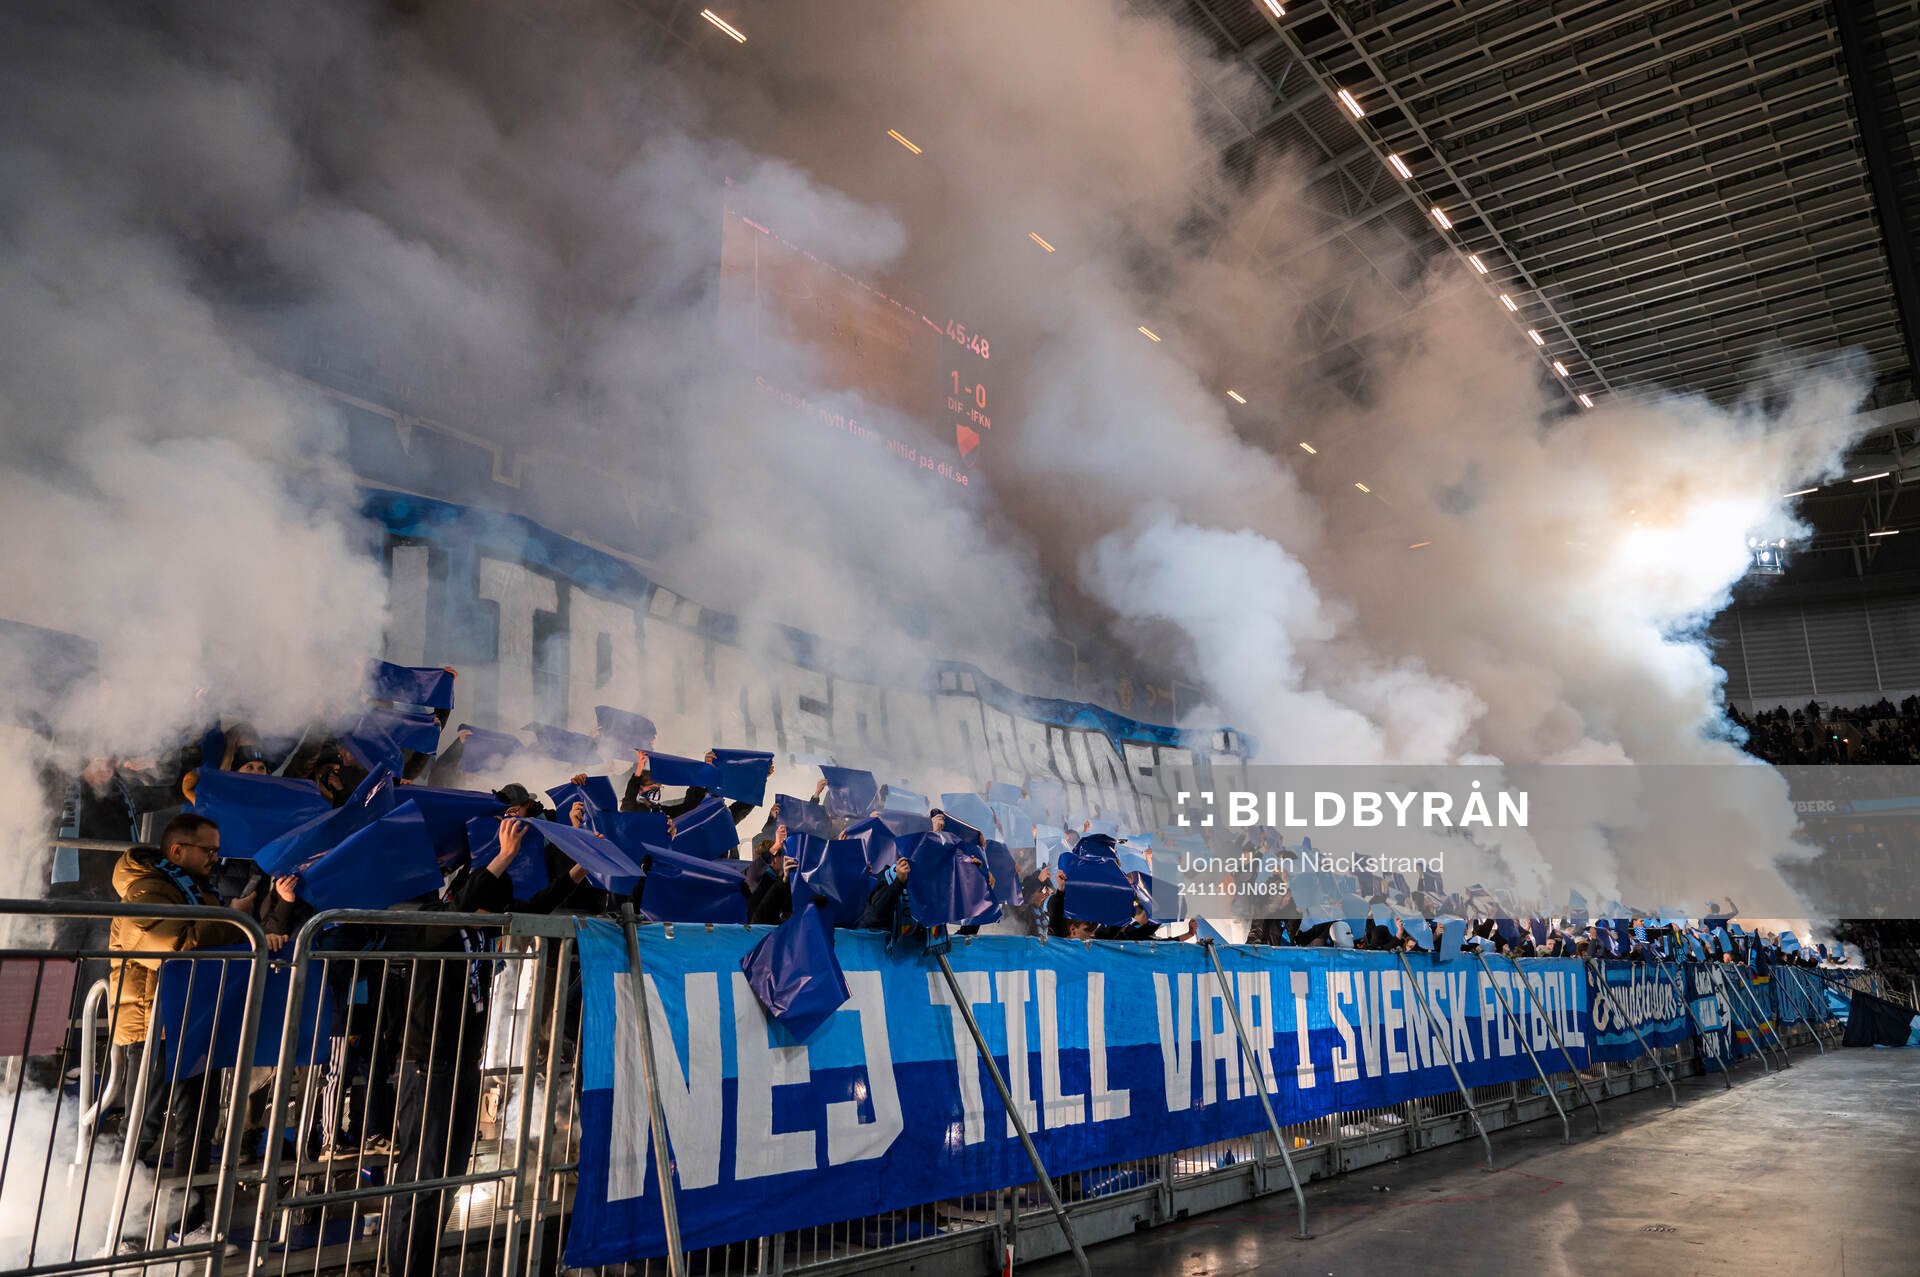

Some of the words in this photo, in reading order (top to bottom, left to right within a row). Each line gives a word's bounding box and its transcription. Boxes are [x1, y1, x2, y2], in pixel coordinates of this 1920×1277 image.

[946, 319, 990, 360] 45:48
[947, 396, 964, 414] DIF
[919, 456, 935, 471] på
[937, 461, 969, 487] dif.se
[607, 969, 905, 1202] NEJ
[926, 968, 1131, 1147] TILL
[1152, 970, 1279, 1112] VAR
[1290, 970, 1316, 1090] I
[1325, 970, 1476, 1084] SVENSK
[1477, 970, 1586, 1062] FOTBOLL
